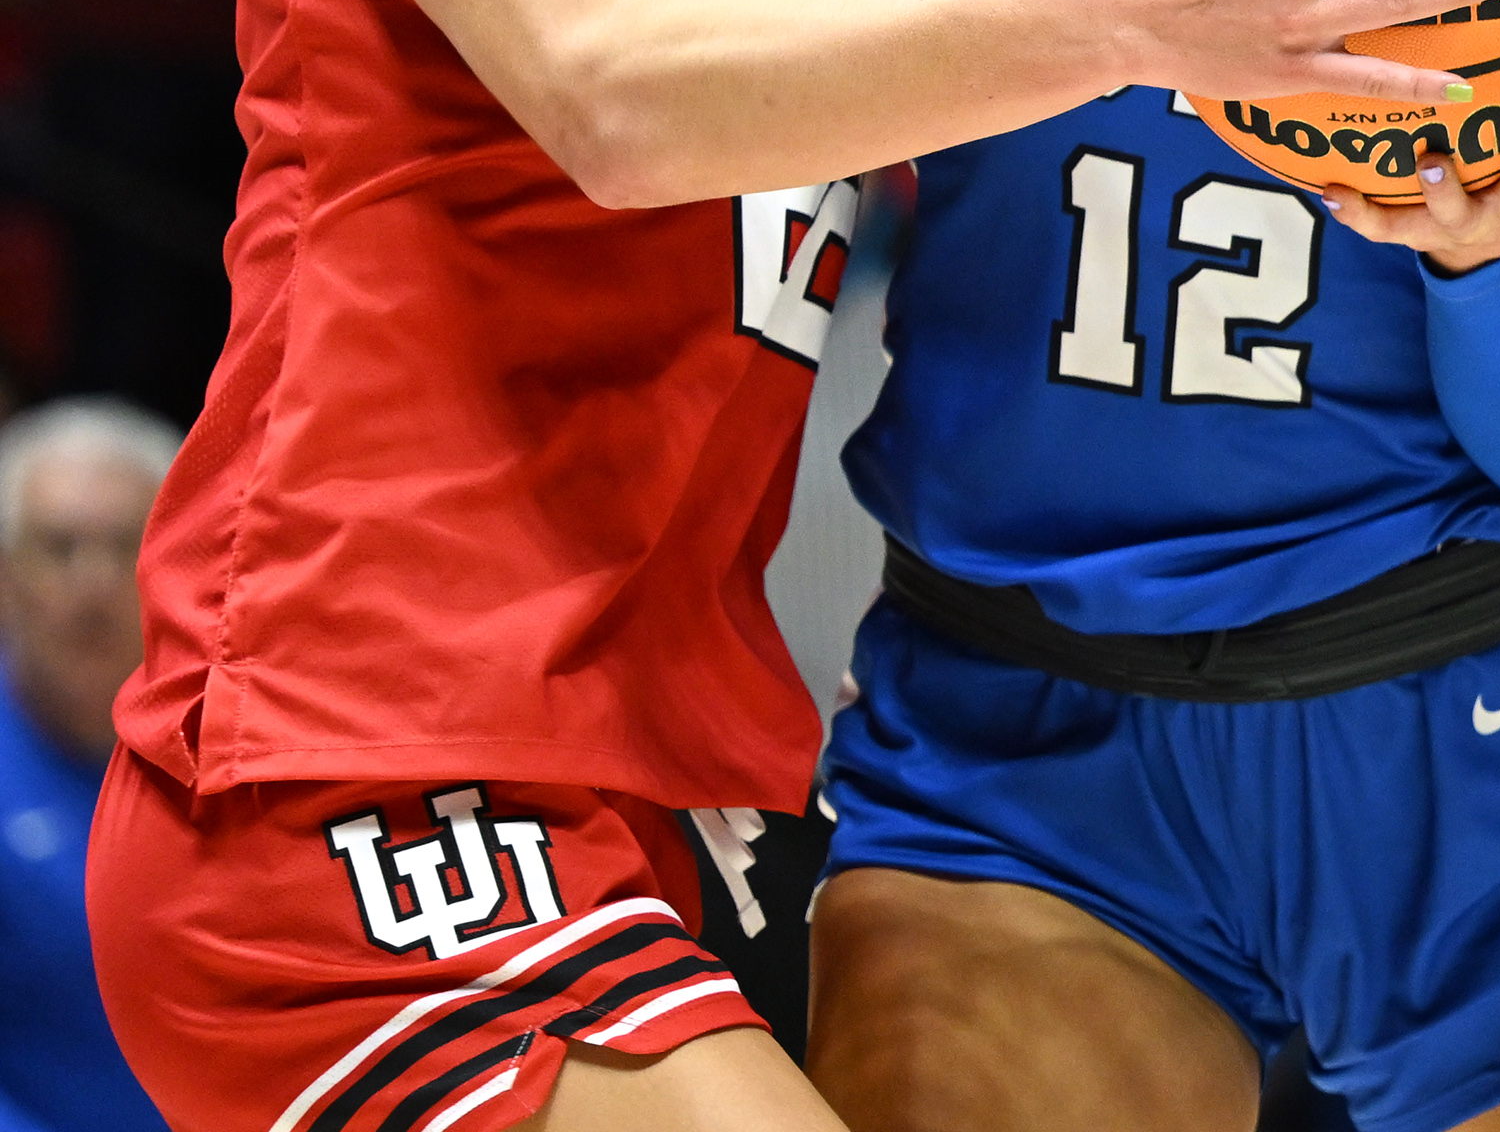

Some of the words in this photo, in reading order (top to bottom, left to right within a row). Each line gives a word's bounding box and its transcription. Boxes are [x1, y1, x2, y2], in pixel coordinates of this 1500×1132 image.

[1326, 111, 1378, 125] NXT
[1386, 106, 1437, 124] EVO
[1048, 144, 1326, 408] 12
